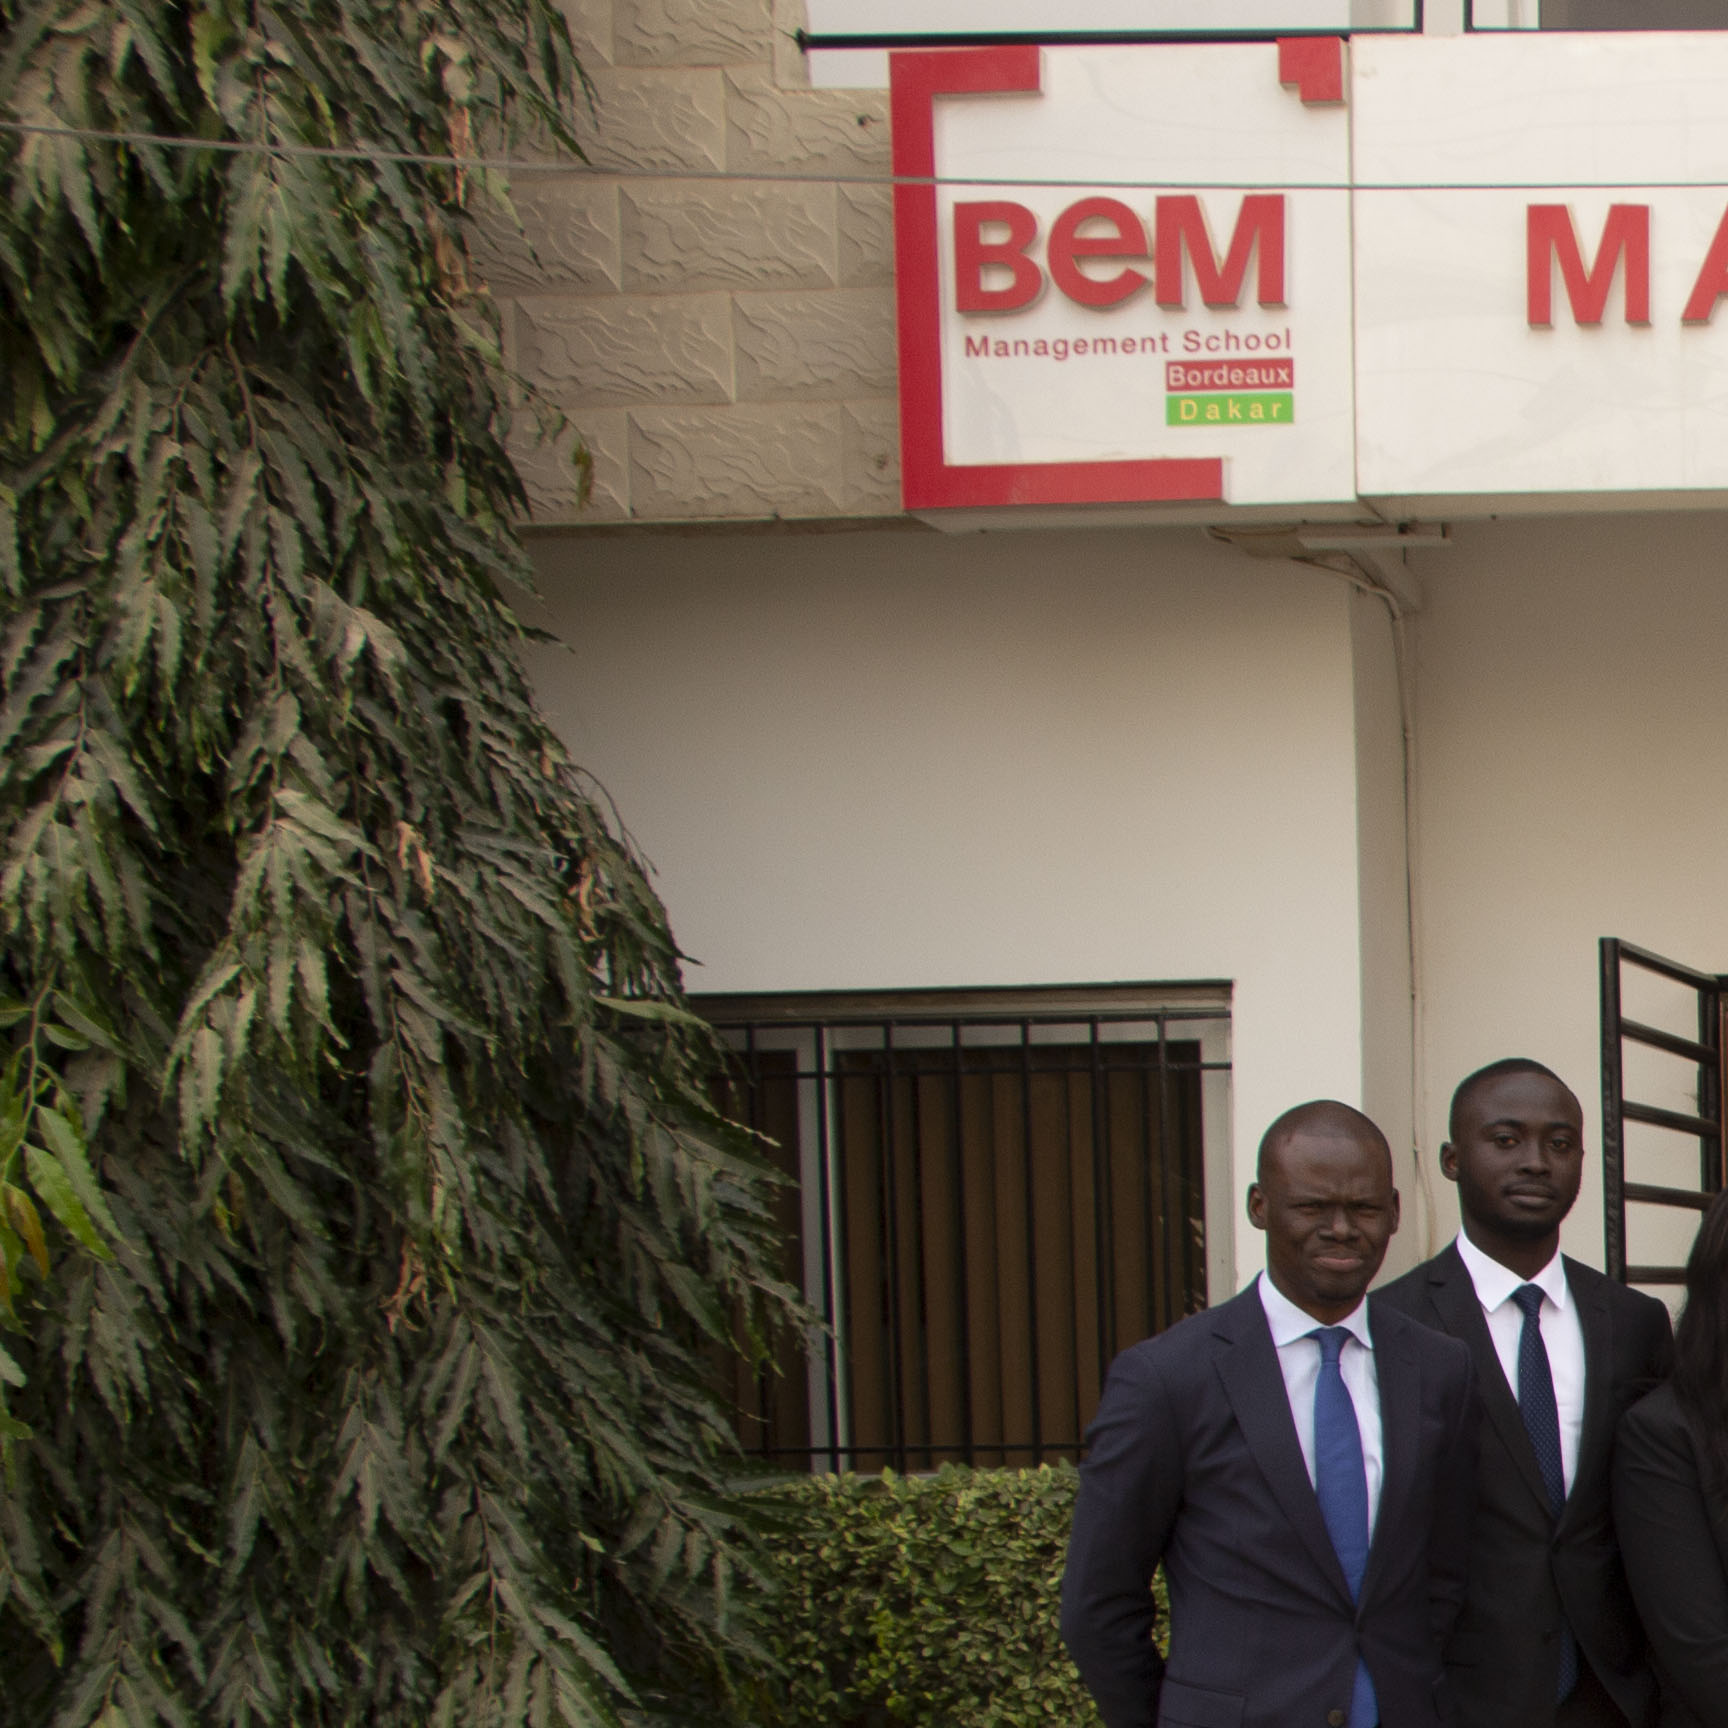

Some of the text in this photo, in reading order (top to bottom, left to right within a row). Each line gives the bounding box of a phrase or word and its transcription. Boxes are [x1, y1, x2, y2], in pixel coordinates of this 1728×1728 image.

[953, 194, 1286, 314] BeM
[963, 328, 1292, 361] Management School
[1168, 361, 1290, 386] Bordeaux
[1180, 398, 1283, 421] Dakar
